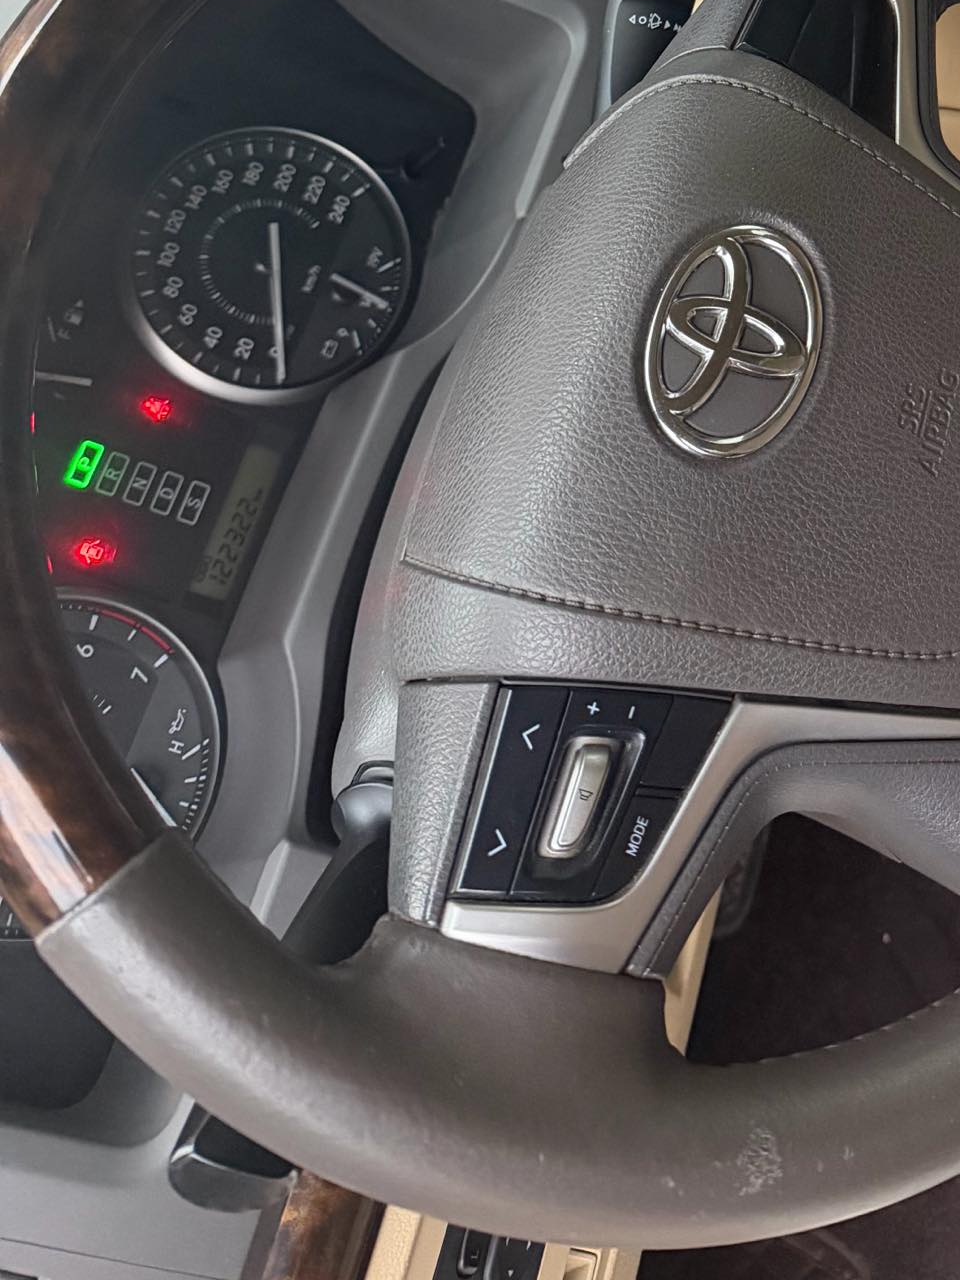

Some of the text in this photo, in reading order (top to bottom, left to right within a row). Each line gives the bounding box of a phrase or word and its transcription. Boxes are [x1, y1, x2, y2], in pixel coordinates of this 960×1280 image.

[211, 169, 234, 194] 160
[242, 161, 264, 186] 180
[273, 163, 297, 192] 200
[185, 184, 207, 210] 140
[303, 175, 326, 205] 220
[164, 209, 187, 234] 120
[327, 195, 350, 224] 240
[157, 242, 180, 267] 100
[162, 276, 184, 298] 80
[302, 265, 321, 293] km/h
[177, 304, 198, 326] 60
[203, 326, 223, 348] 40
[234, 337, 255, 360] 20
[920, 368, 960, 477] AIRBAG
[105, 467, 121, 480] R
[132, 477, 148, 490] N
[159, 487, 176, 501] D
[187, 496, 202, 509] S
[207, 496, 257, 585] 122322
[76, 643, 95, 658] 6
[130, 666, 149, 683] 7
[168, 740, 185, 755] H
[625, 815, 649, 857] MODE
